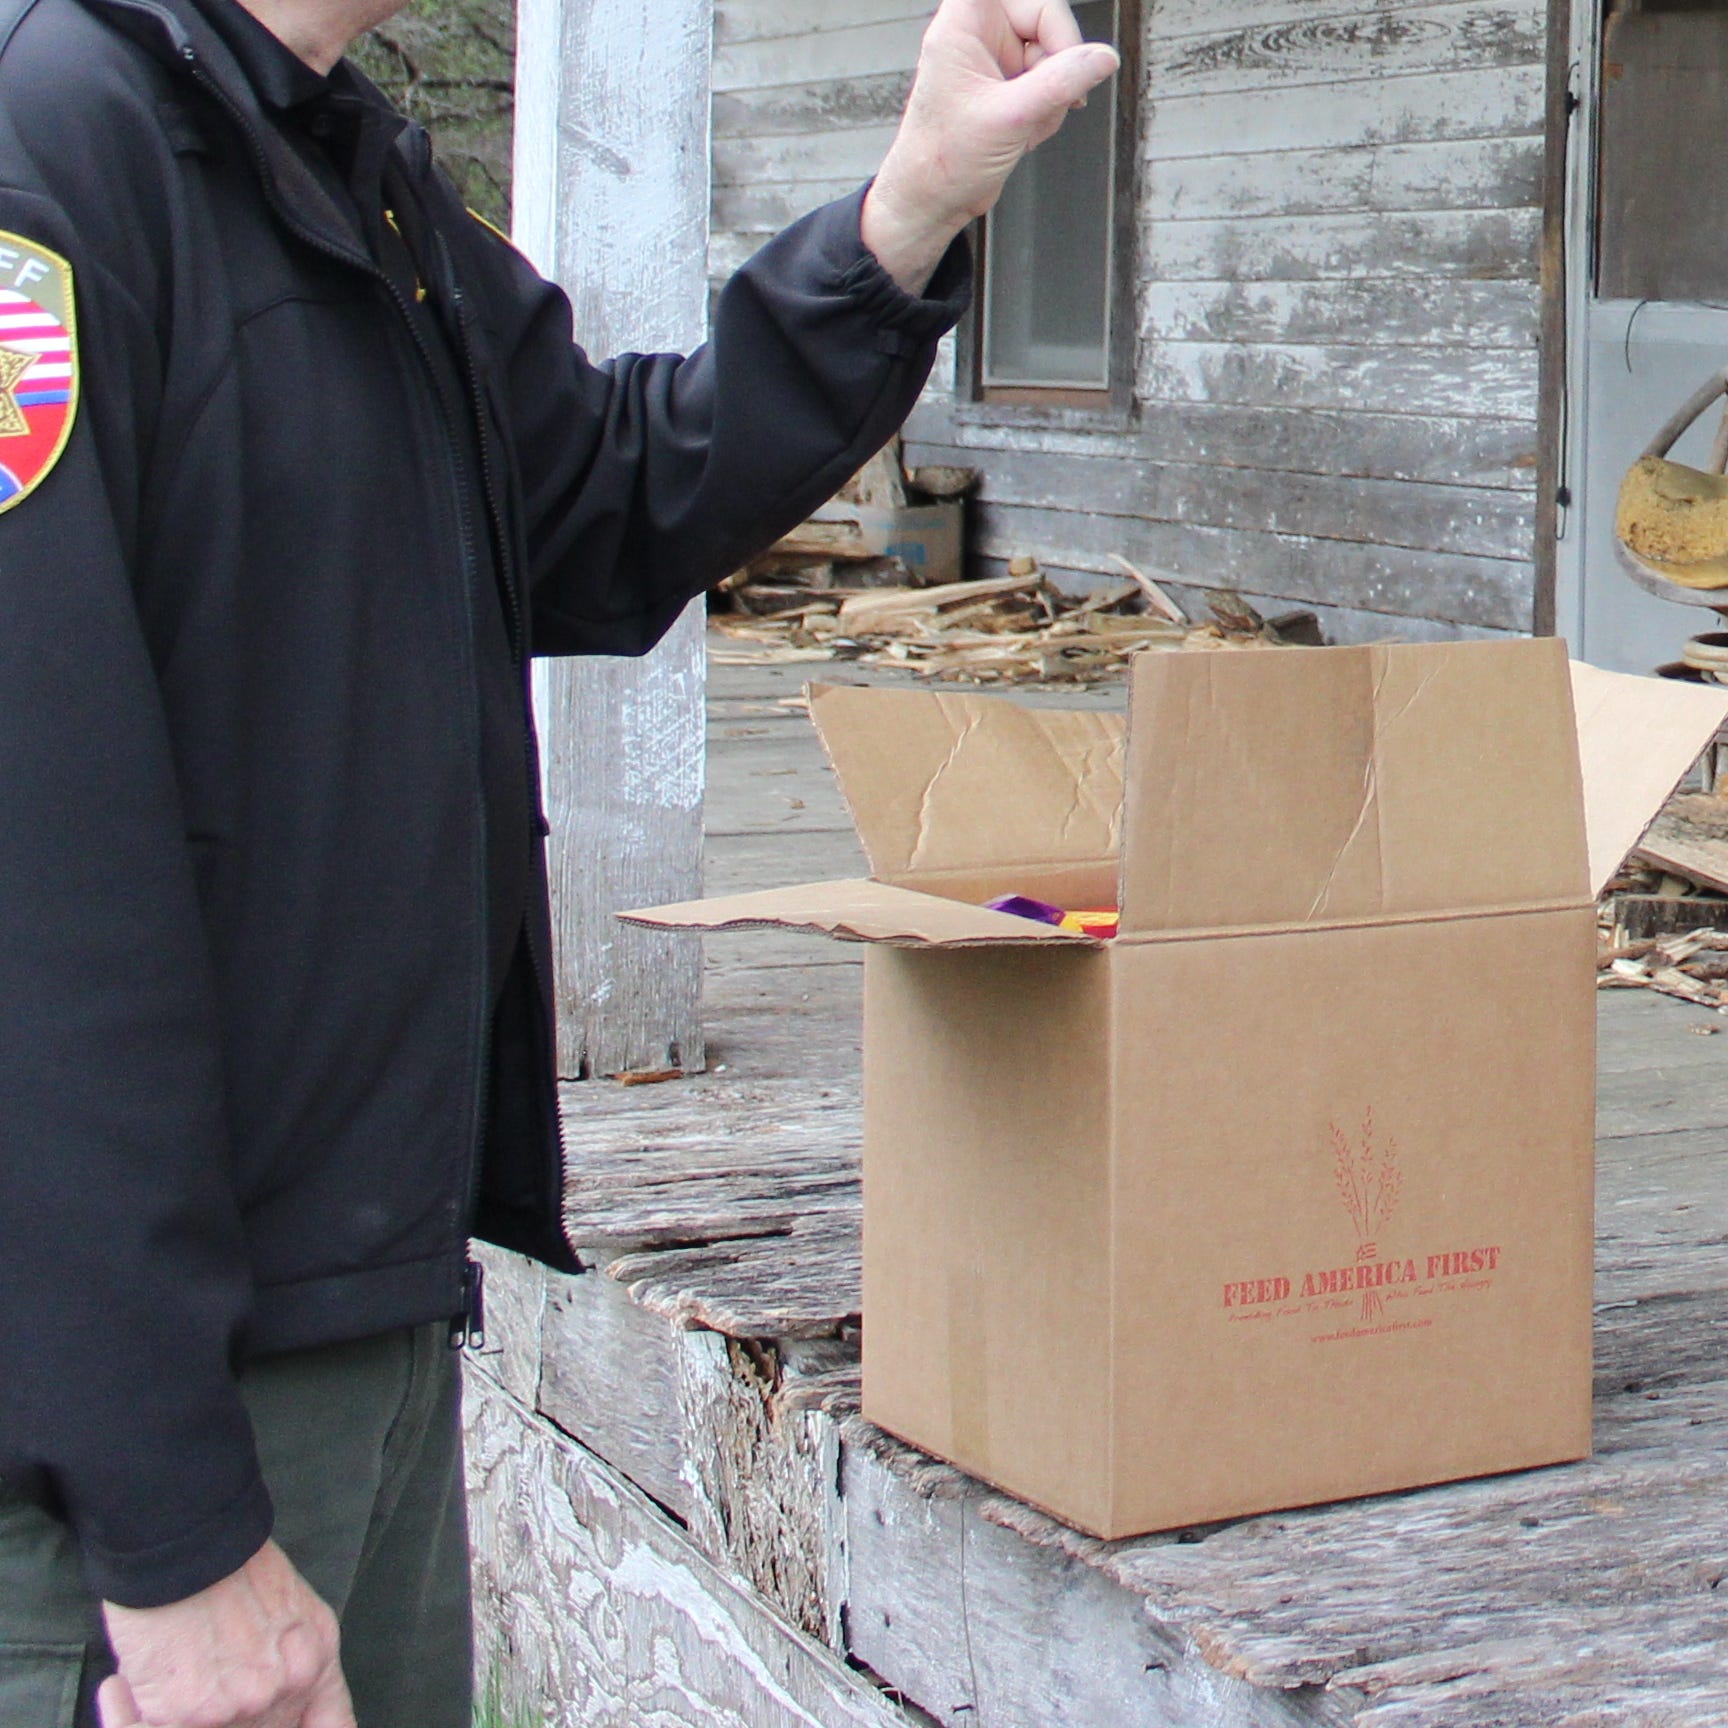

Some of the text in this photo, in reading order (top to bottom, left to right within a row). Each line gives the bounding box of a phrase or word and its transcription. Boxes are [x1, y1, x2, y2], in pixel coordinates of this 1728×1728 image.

[1224, 1245, 1501, 1307] FEED AMERICA FIRST
